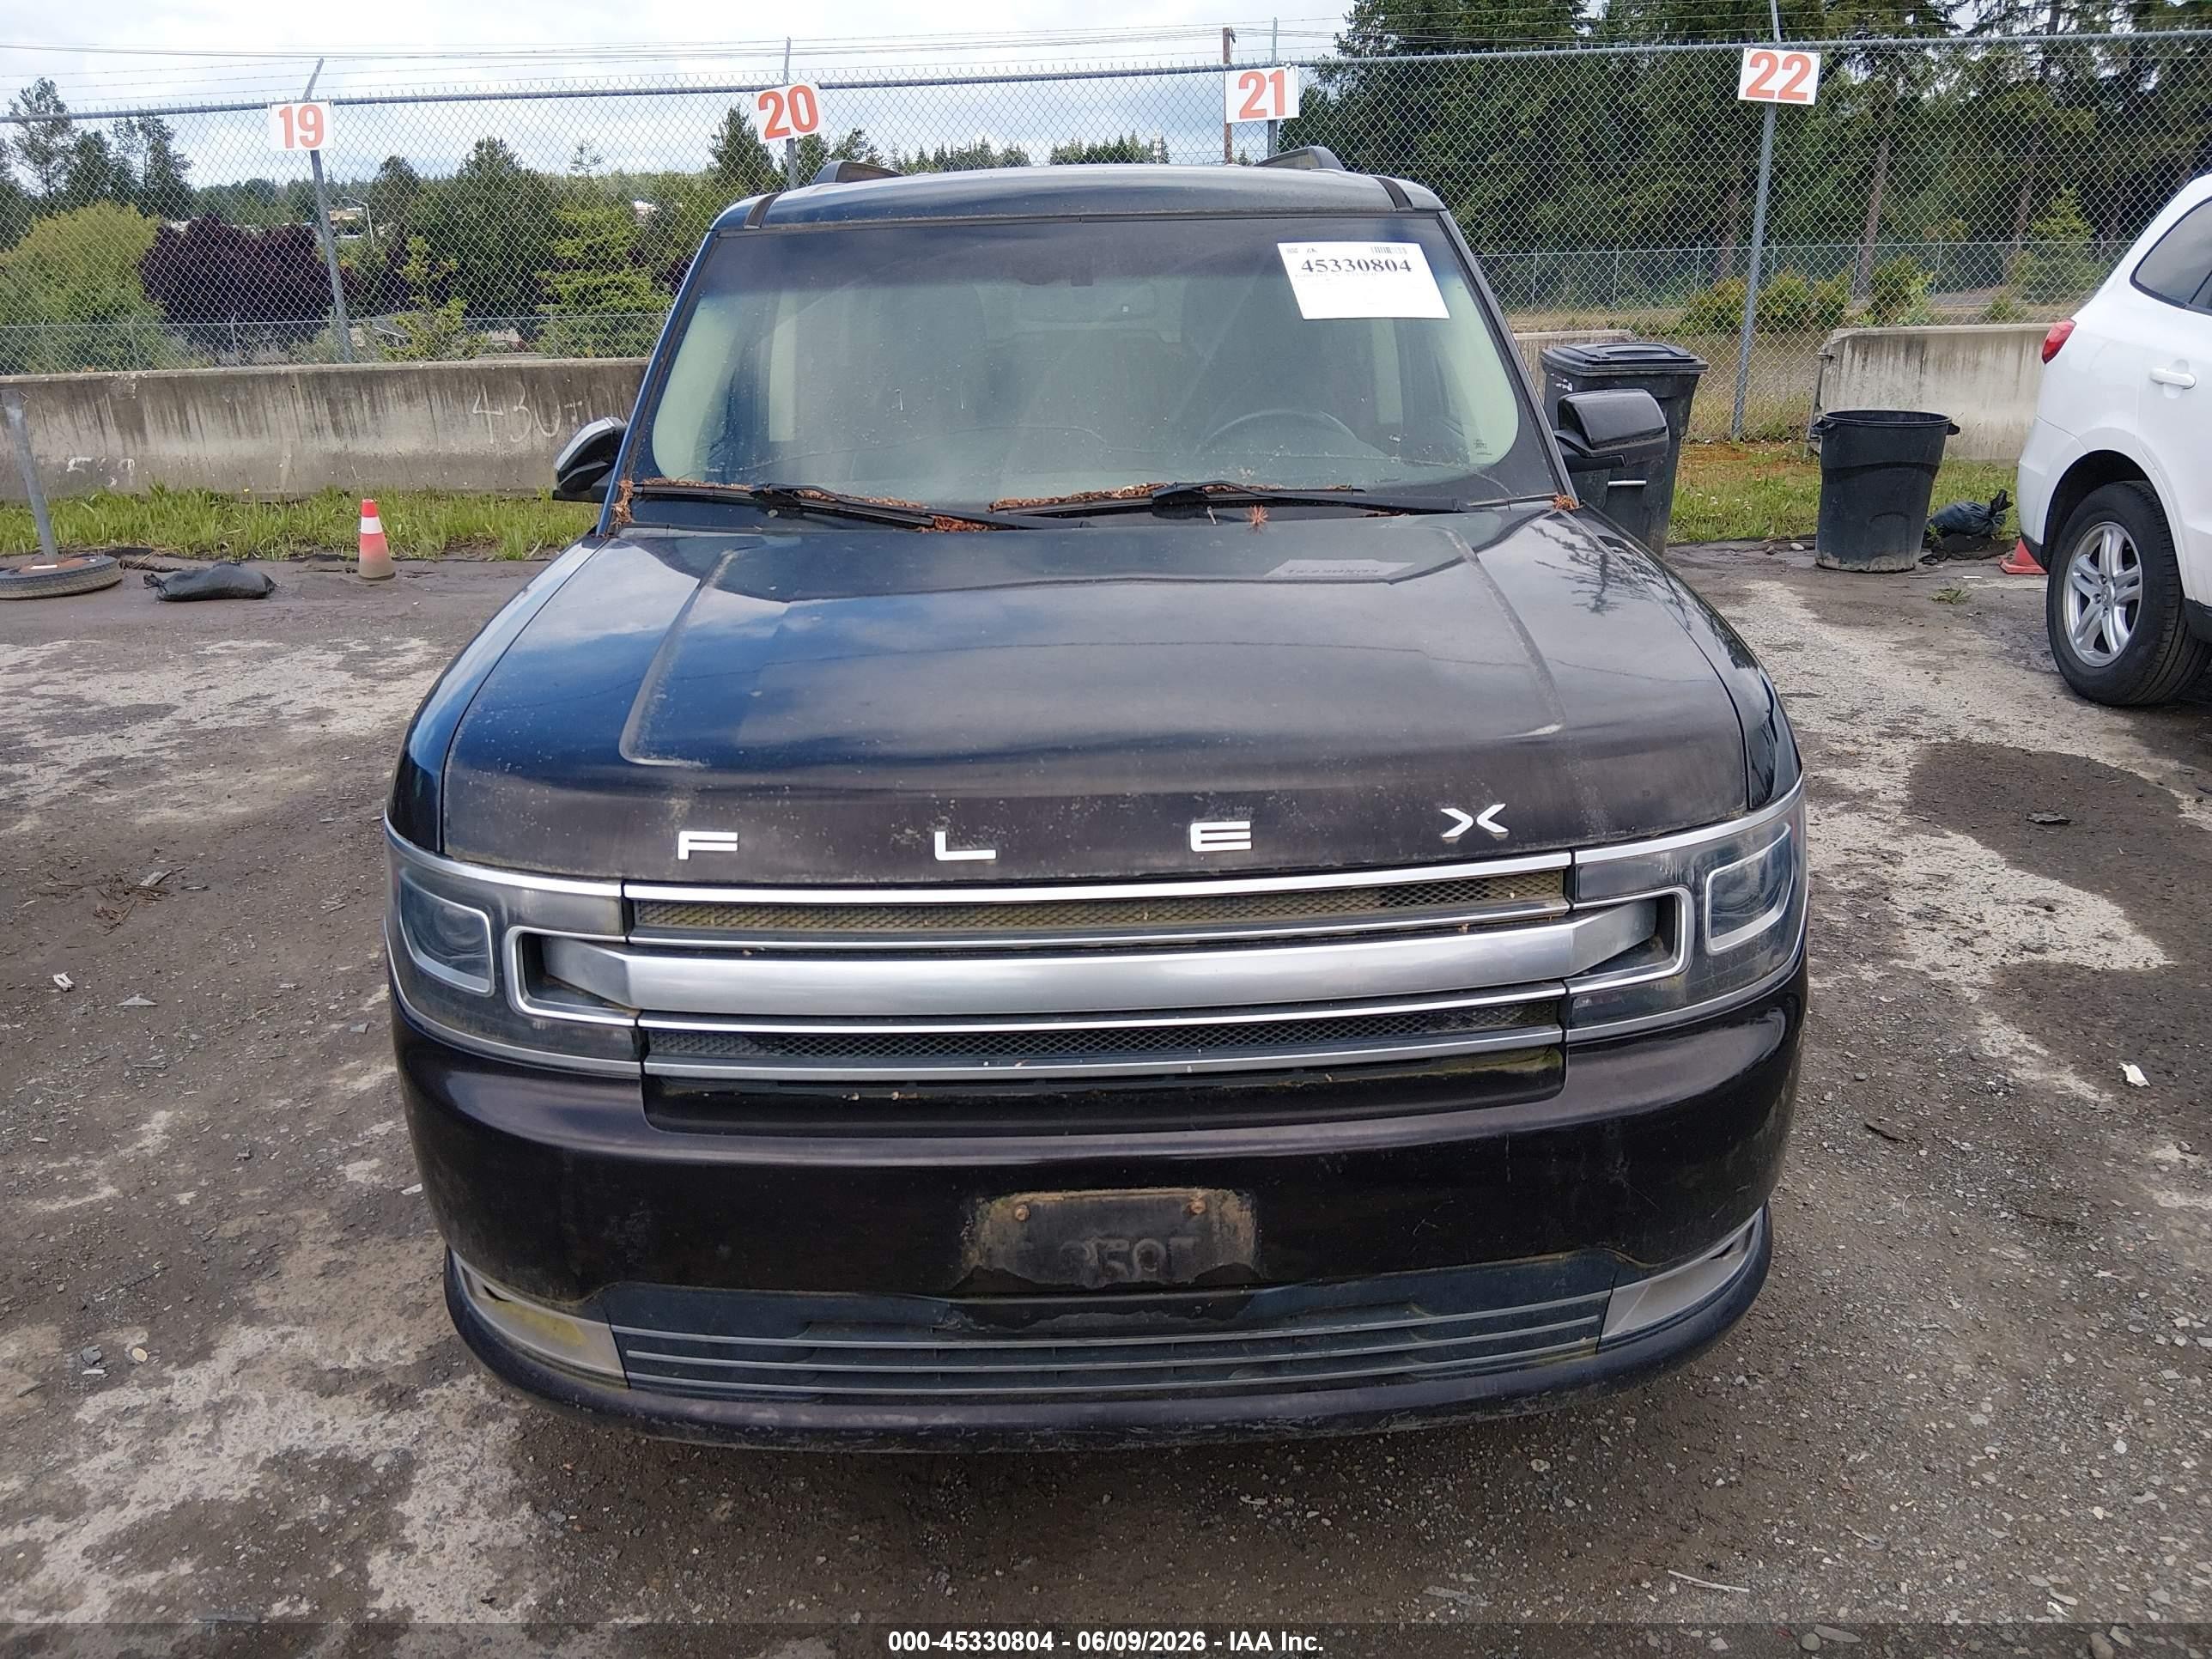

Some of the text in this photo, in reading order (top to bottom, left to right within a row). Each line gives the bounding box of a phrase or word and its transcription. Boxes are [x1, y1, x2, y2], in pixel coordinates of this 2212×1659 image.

[1238, 70, 1285, 118] 21
[1746, 52, 1809, 101] 22
[279, 104, 324, 149] 19
[758, 84, 819, 139] 20
[1301, 258, 1412, 273] 45330804
